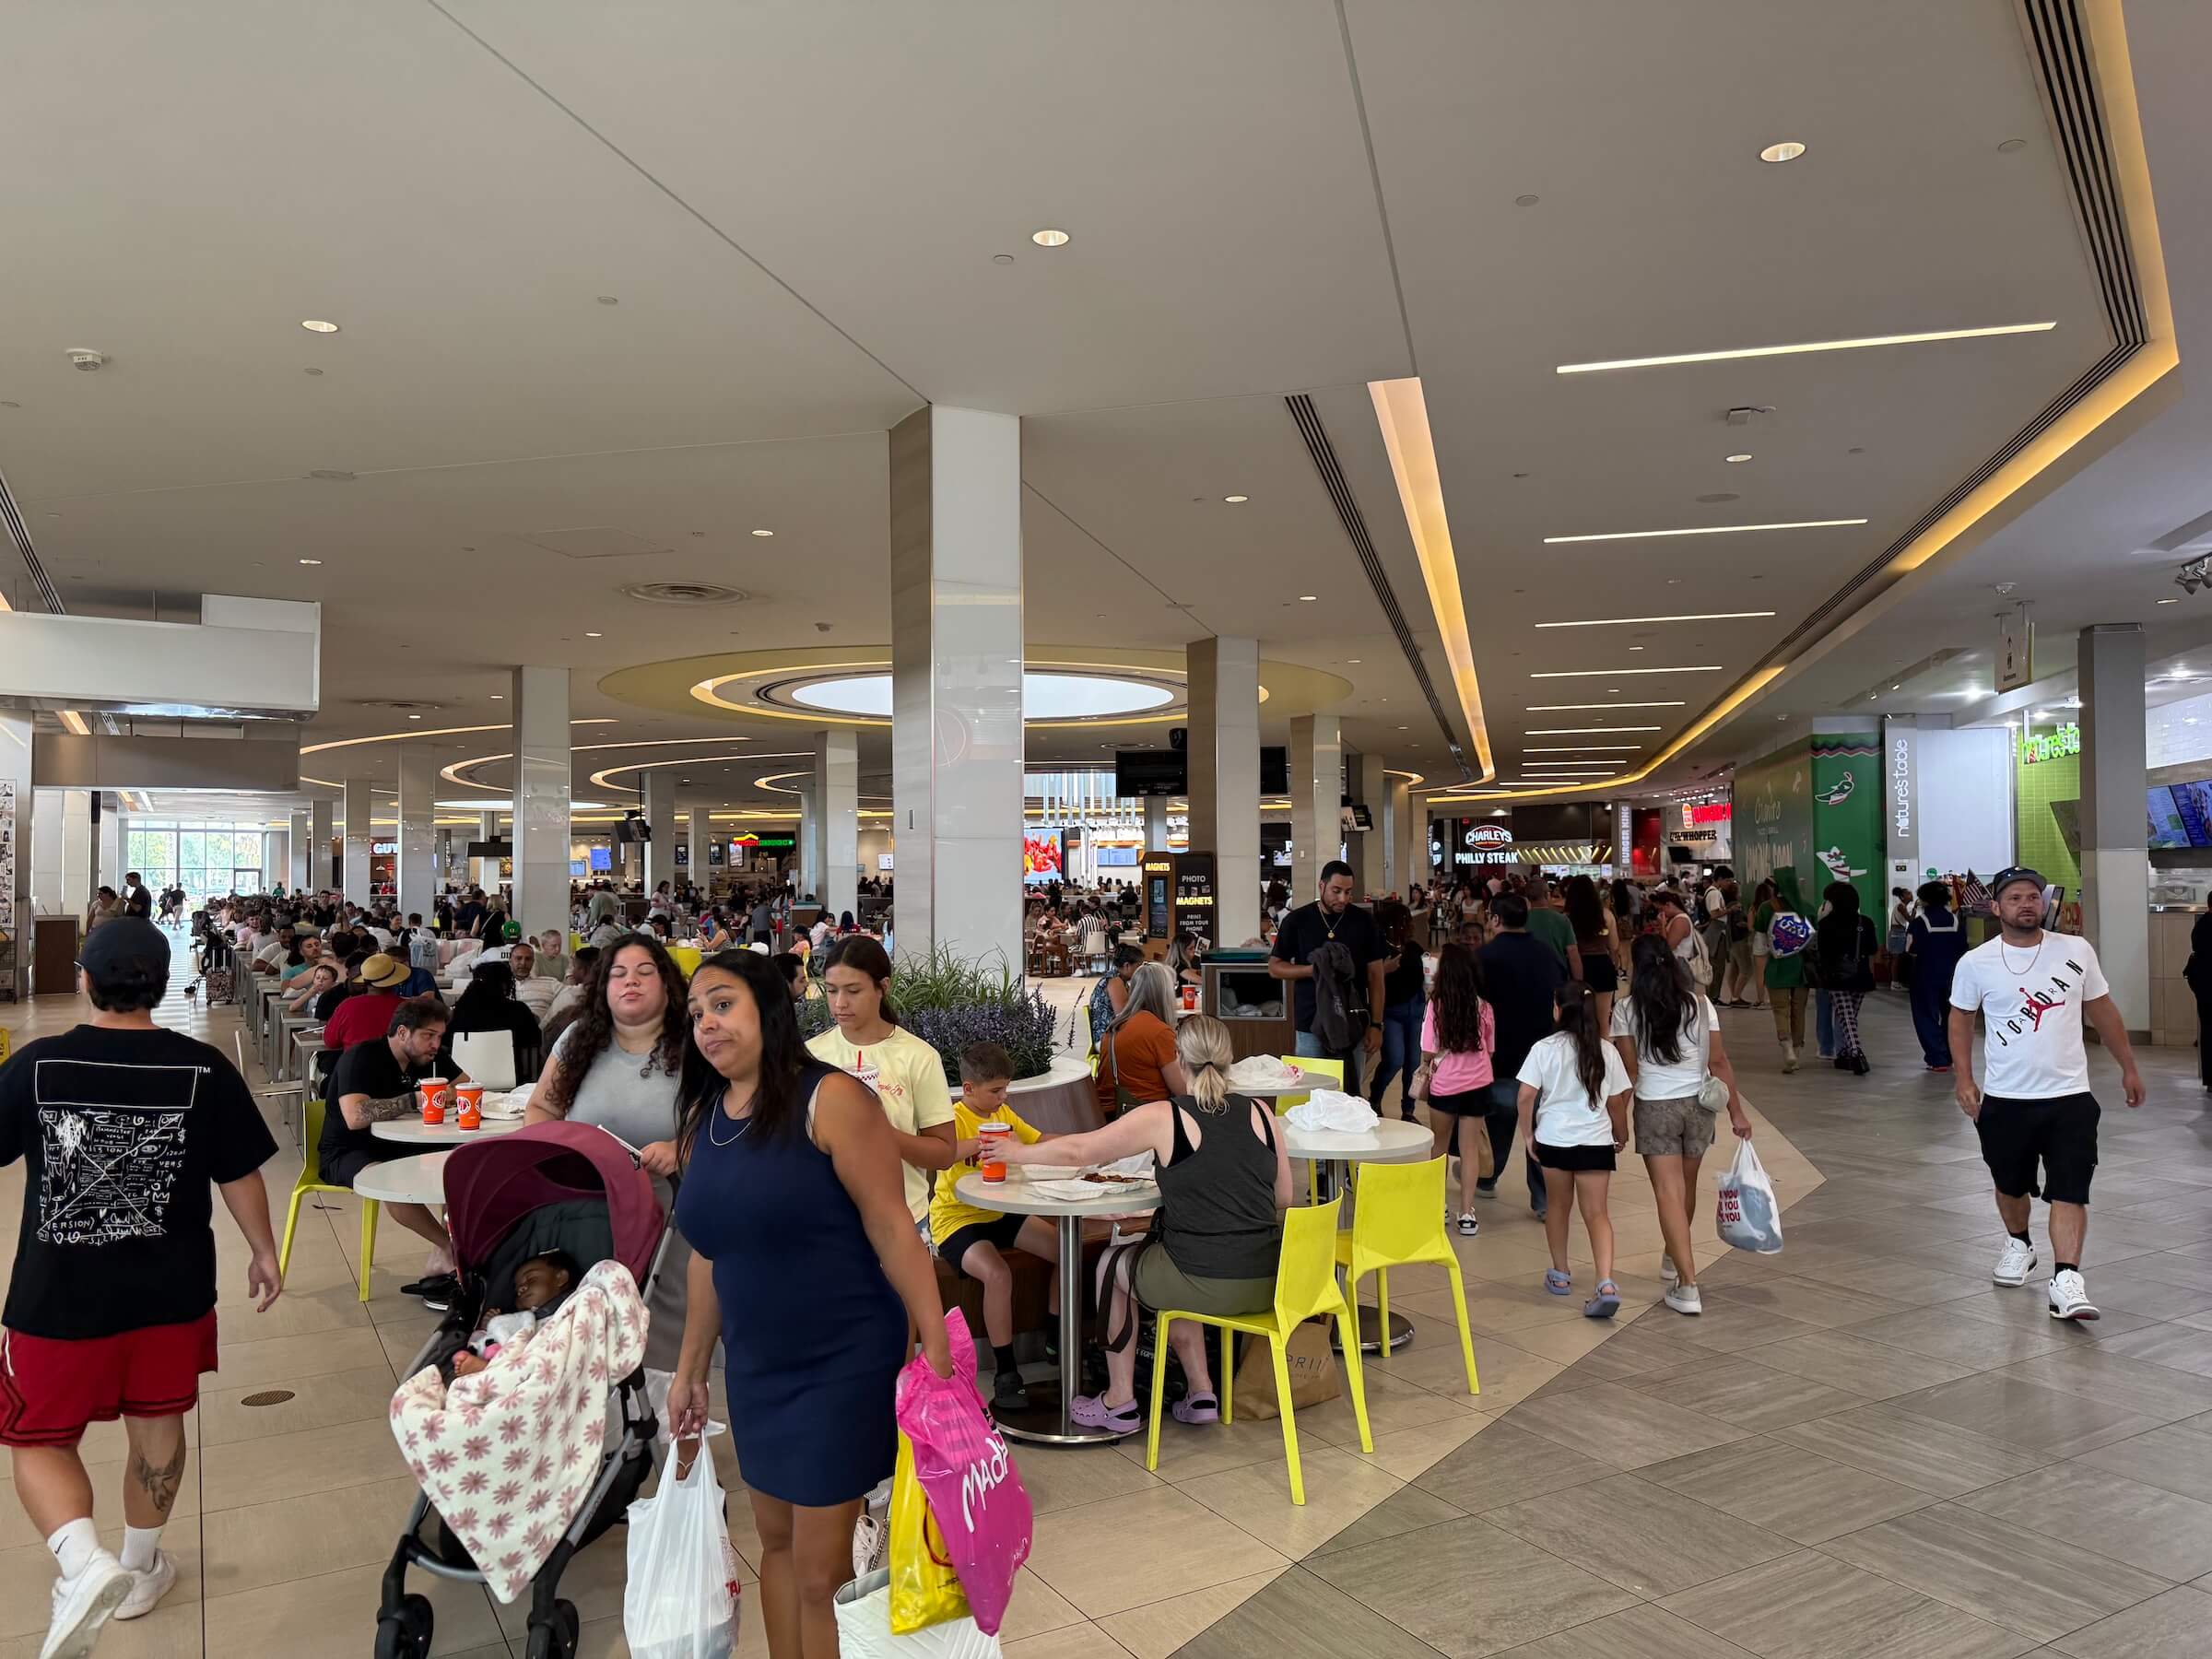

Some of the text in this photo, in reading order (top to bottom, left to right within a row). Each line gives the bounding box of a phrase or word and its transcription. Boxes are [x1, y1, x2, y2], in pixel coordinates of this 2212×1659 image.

[1893, 738, 1910, 838] nature's table
[1455, 852, 1518, 865] PHILLY STEAK
[1146, 863, 1171, 872] MAGNETS
[1176, 896, 1213, 905] MAGNETS
[1996, 959, 2083, 1046] JORDAN
[1724, 1200, 1739, 1210] YOU
[1725, 1212, 1741, 1222] YOU
